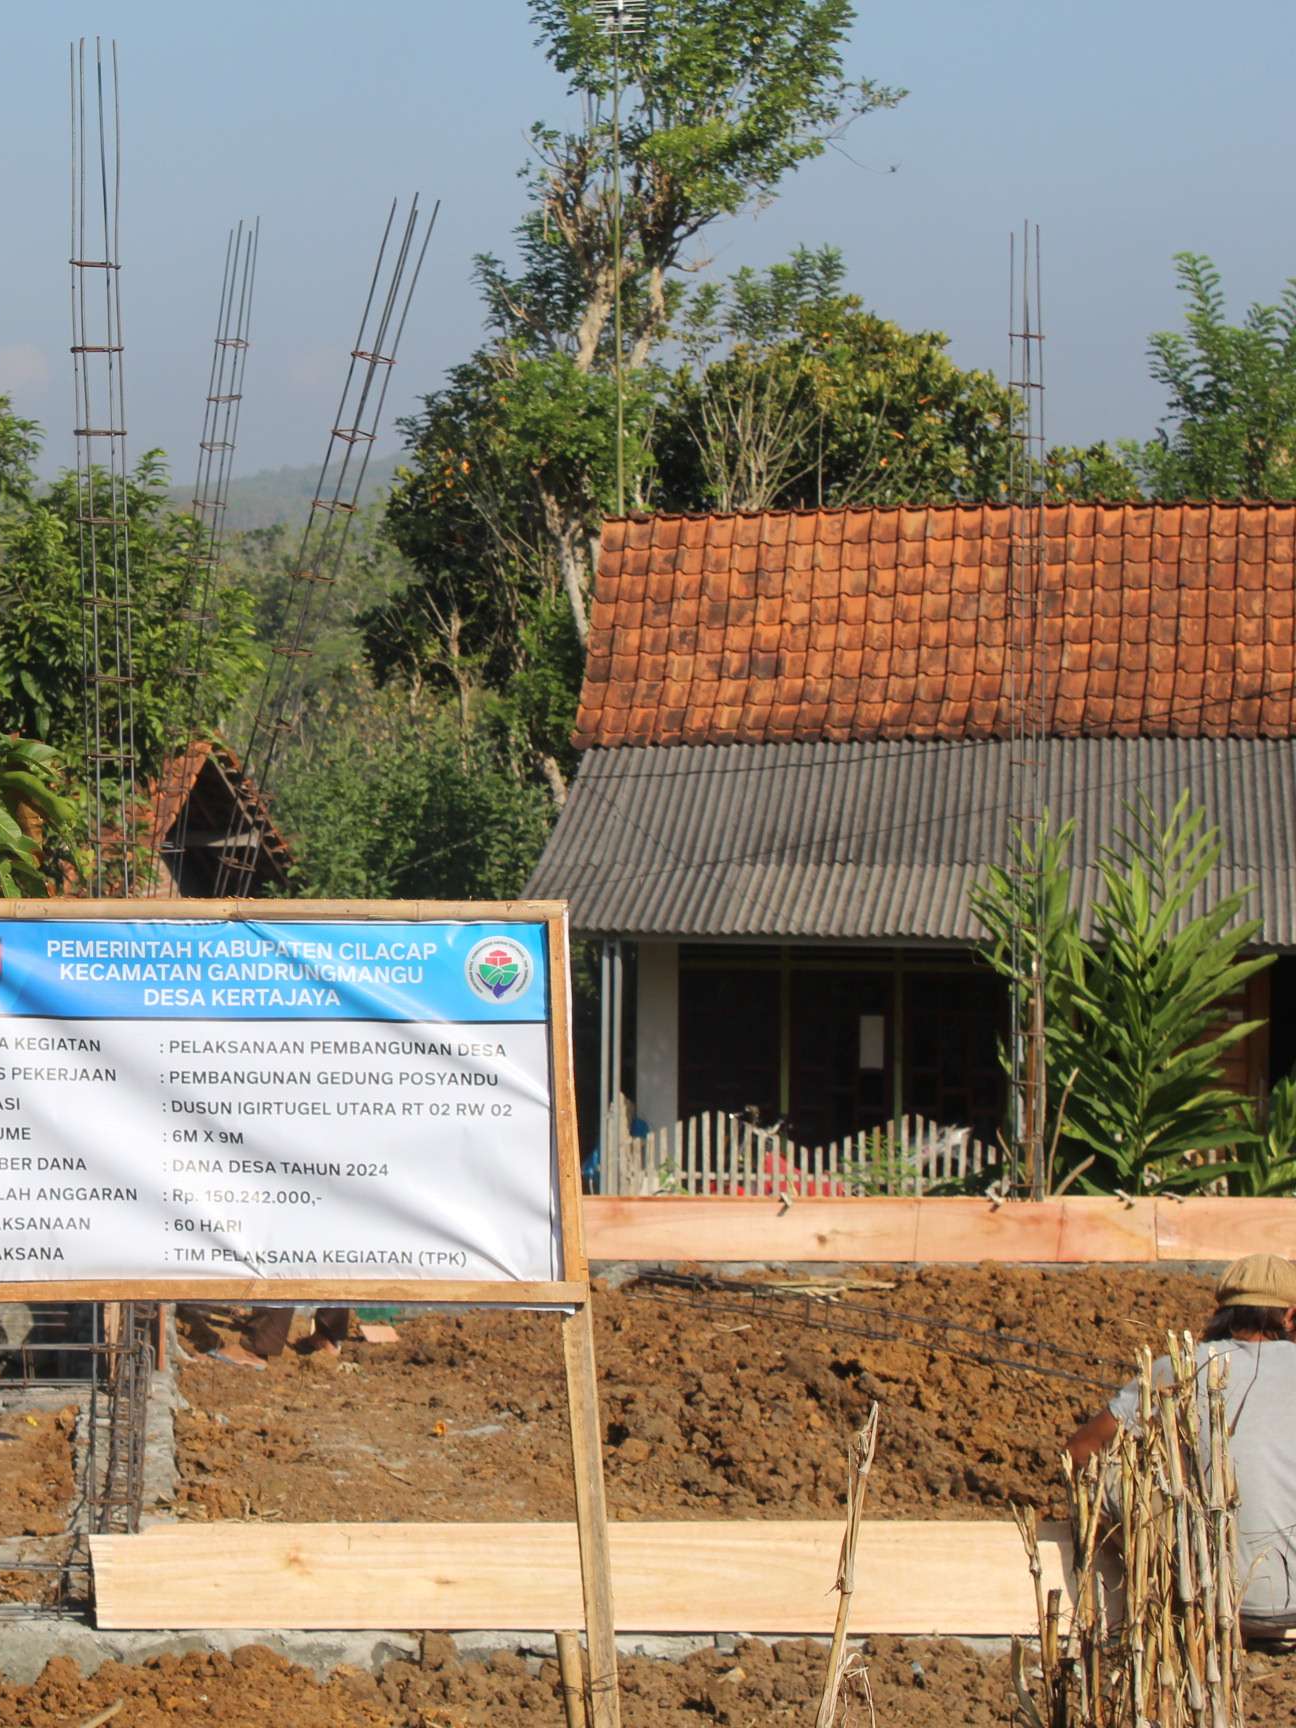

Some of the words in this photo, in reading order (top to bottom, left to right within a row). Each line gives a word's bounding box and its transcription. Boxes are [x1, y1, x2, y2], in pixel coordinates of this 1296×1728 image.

[47, 940, 192, 958] PEMERINTAH
[198, 940, 332, 960] KABUPATEN
[339, 943, 437, 960] CILACAP
[60, 964, 202, 981] KECAMATAN
[208, 964, 423, 984] GANDRUNGMANGU
[144, 988, 205, 1006] DESA
[212, 988, 340, 1006] KERTAJAYA
[14, 1037, 101, 1052] KEGIATAN
[169, 1040, 304, 1054] PELAKSANAAN
[310, 1041, 452, 1056] PEMBANGUNAN
[458, 1043, 506, 1057] DESA
[11, 1067, 116, 1082] PEKERJAAN
[169, 1071, 311, 1085] PEMBANGUNAN
[316, 1071, 393, 1085] GEDUNG
[399, 1072, 498, 1087] POSYANDU
[171, 1100, 232, 1114] DUSUN
[237, 1101, 331, 1115] IGIRTUGEL
[336, 1103, 396, 1116] UTARA
[402, 1103, 423, 1116] RT
[429, 1103, 451, 1117] 02
[456, 1104, 485, 1117] RW
[490, 1104, 512, 1118] 02
[172, 1130, 198, 1143] 6M
[219, 1132, 244, 1144] 9M
[37, 1157, 87, 1171] DANA
[172, 1160, 224, 1173] DANA
[229, 1160, 277, 1174] DESA
[280, 1161, 341, 1177] TAHUN
[346, 1164, 389, 1177] 2024
[36, 1187, 138, 1201] ANGGARAN
[172, 1189, 200, 1205] Rp.
[205, 1190, 322, 1206] 150.242.000,-
[174, 1219, 195, 1232] 60
[199, 1220, 243, 1233] HARI
[174, 1248, 206, 1262] TIM
[211, 1249, 318, 1265] PELAKSANA
[322, 1250, 413, 1264] KEGIATAN
[418, 1251, 468, 1268] (TPK)
